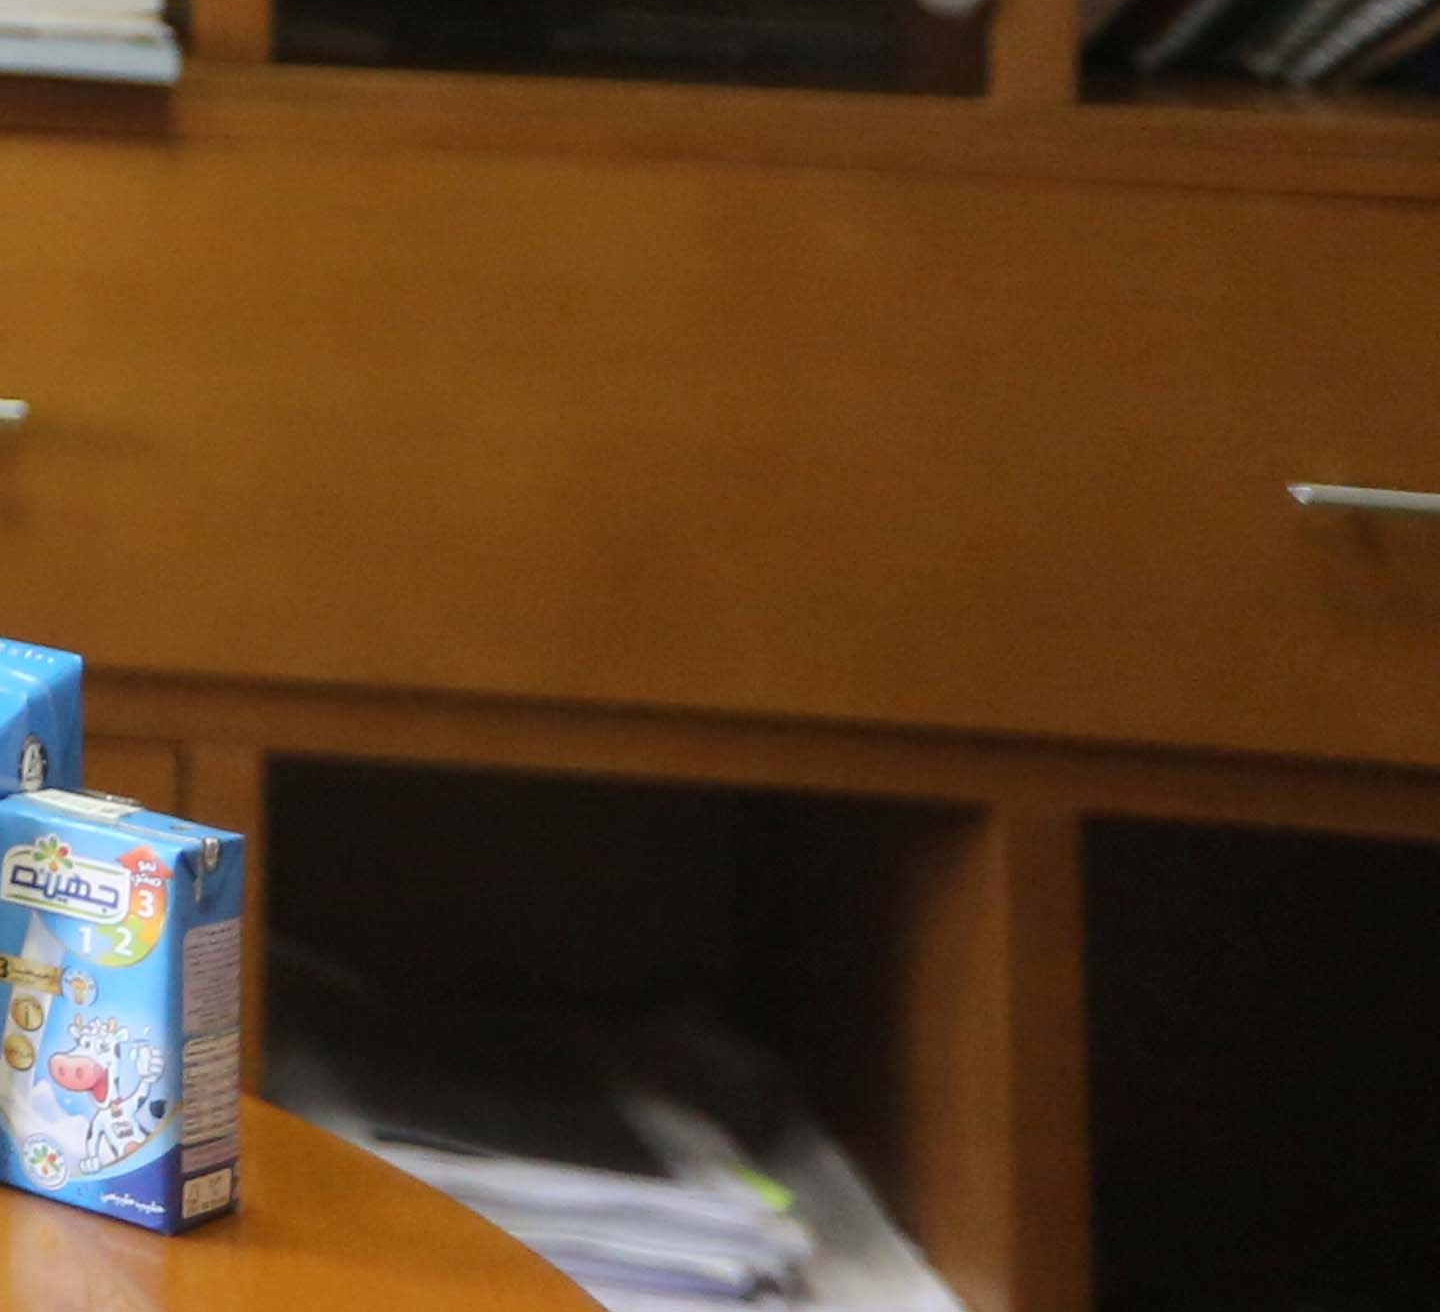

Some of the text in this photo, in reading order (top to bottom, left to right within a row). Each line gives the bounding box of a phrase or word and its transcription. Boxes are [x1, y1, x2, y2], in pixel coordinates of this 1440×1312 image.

[137, 890, 155, 918] 3
[79, 927, 92, 954] 1
[113, 928, 134, 956] 2
